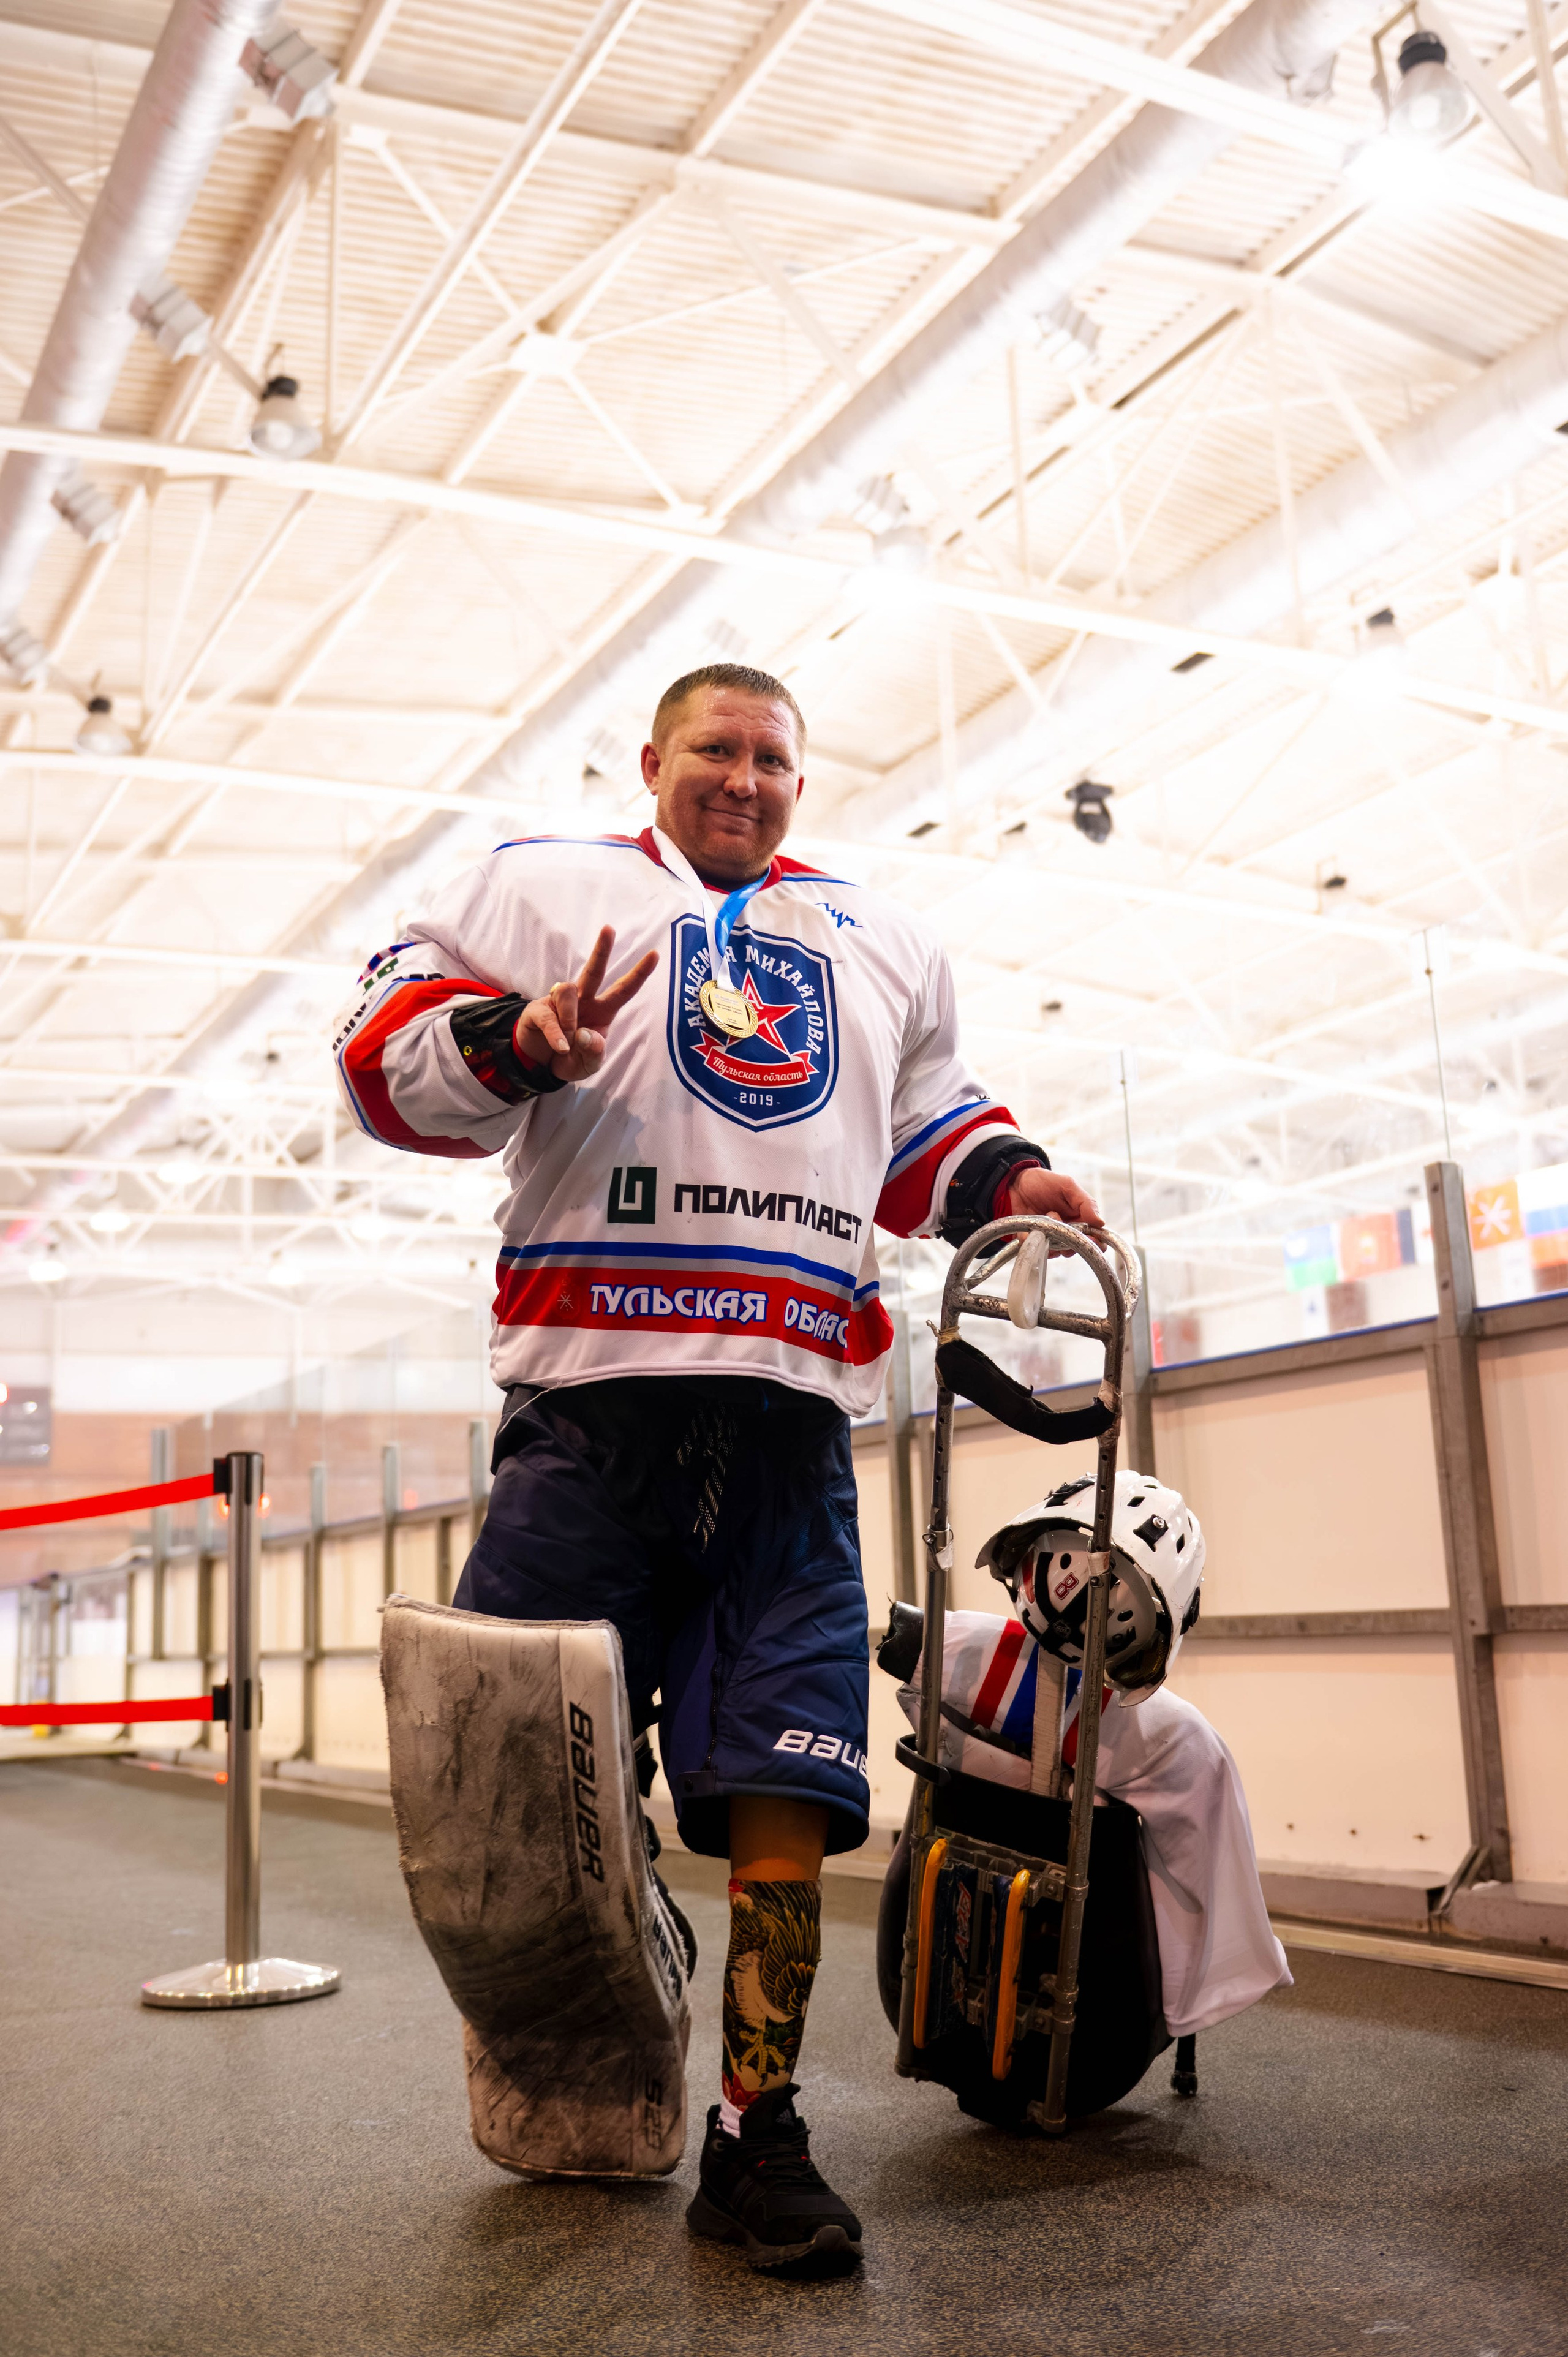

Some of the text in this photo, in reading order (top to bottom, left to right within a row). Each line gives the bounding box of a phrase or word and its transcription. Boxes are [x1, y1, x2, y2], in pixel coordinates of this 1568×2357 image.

[684, 945, 824, 1055] АКАДЕМЯ МИХАЙЛОВА
[712, 1057, 804, 1082] Тульская область
[674, 1183, 862, 1244] ПОЛИПЛАСТ
[589, 1284, 768, 1324] ТУЛЬСКАЯ
